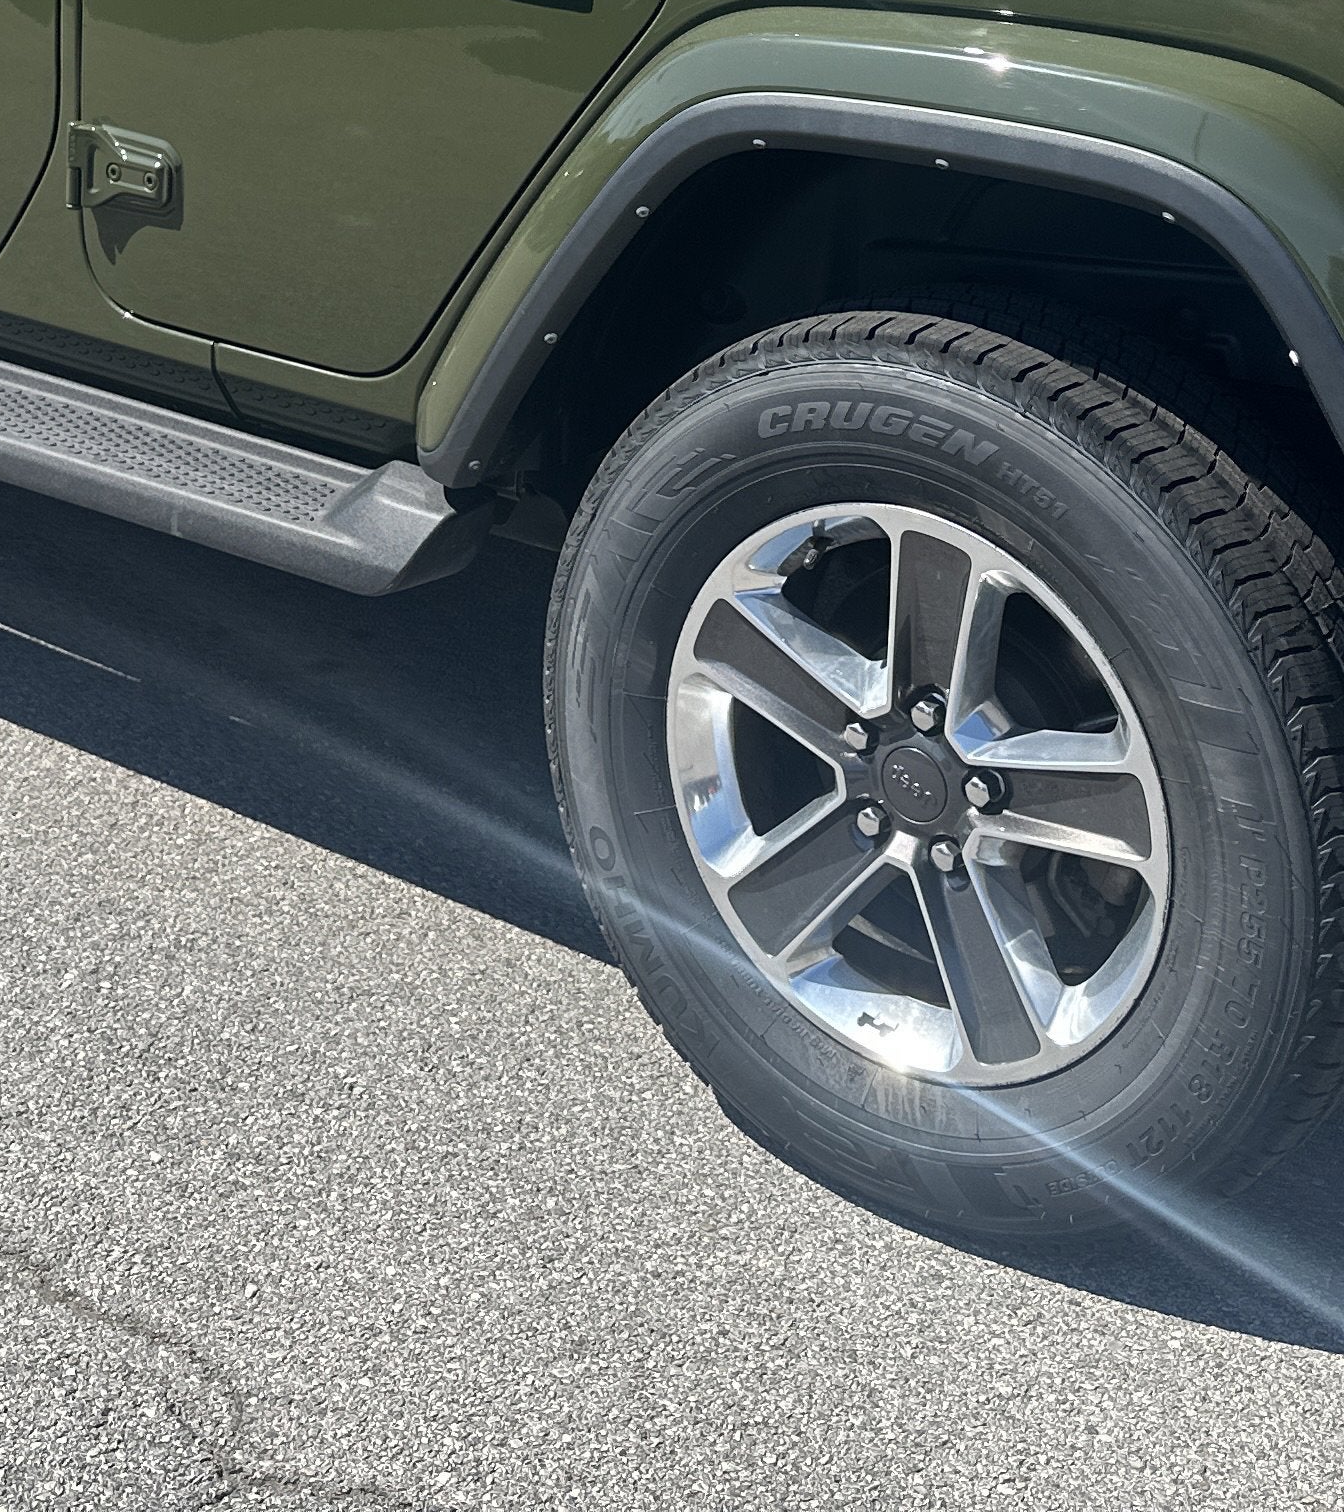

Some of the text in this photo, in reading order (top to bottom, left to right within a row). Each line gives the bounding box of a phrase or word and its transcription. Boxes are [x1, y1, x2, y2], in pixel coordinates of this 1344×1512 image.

[758, 401, 1070, 520] CRUGEN HT51
[589, 825, 721, 1060] KUMHO
